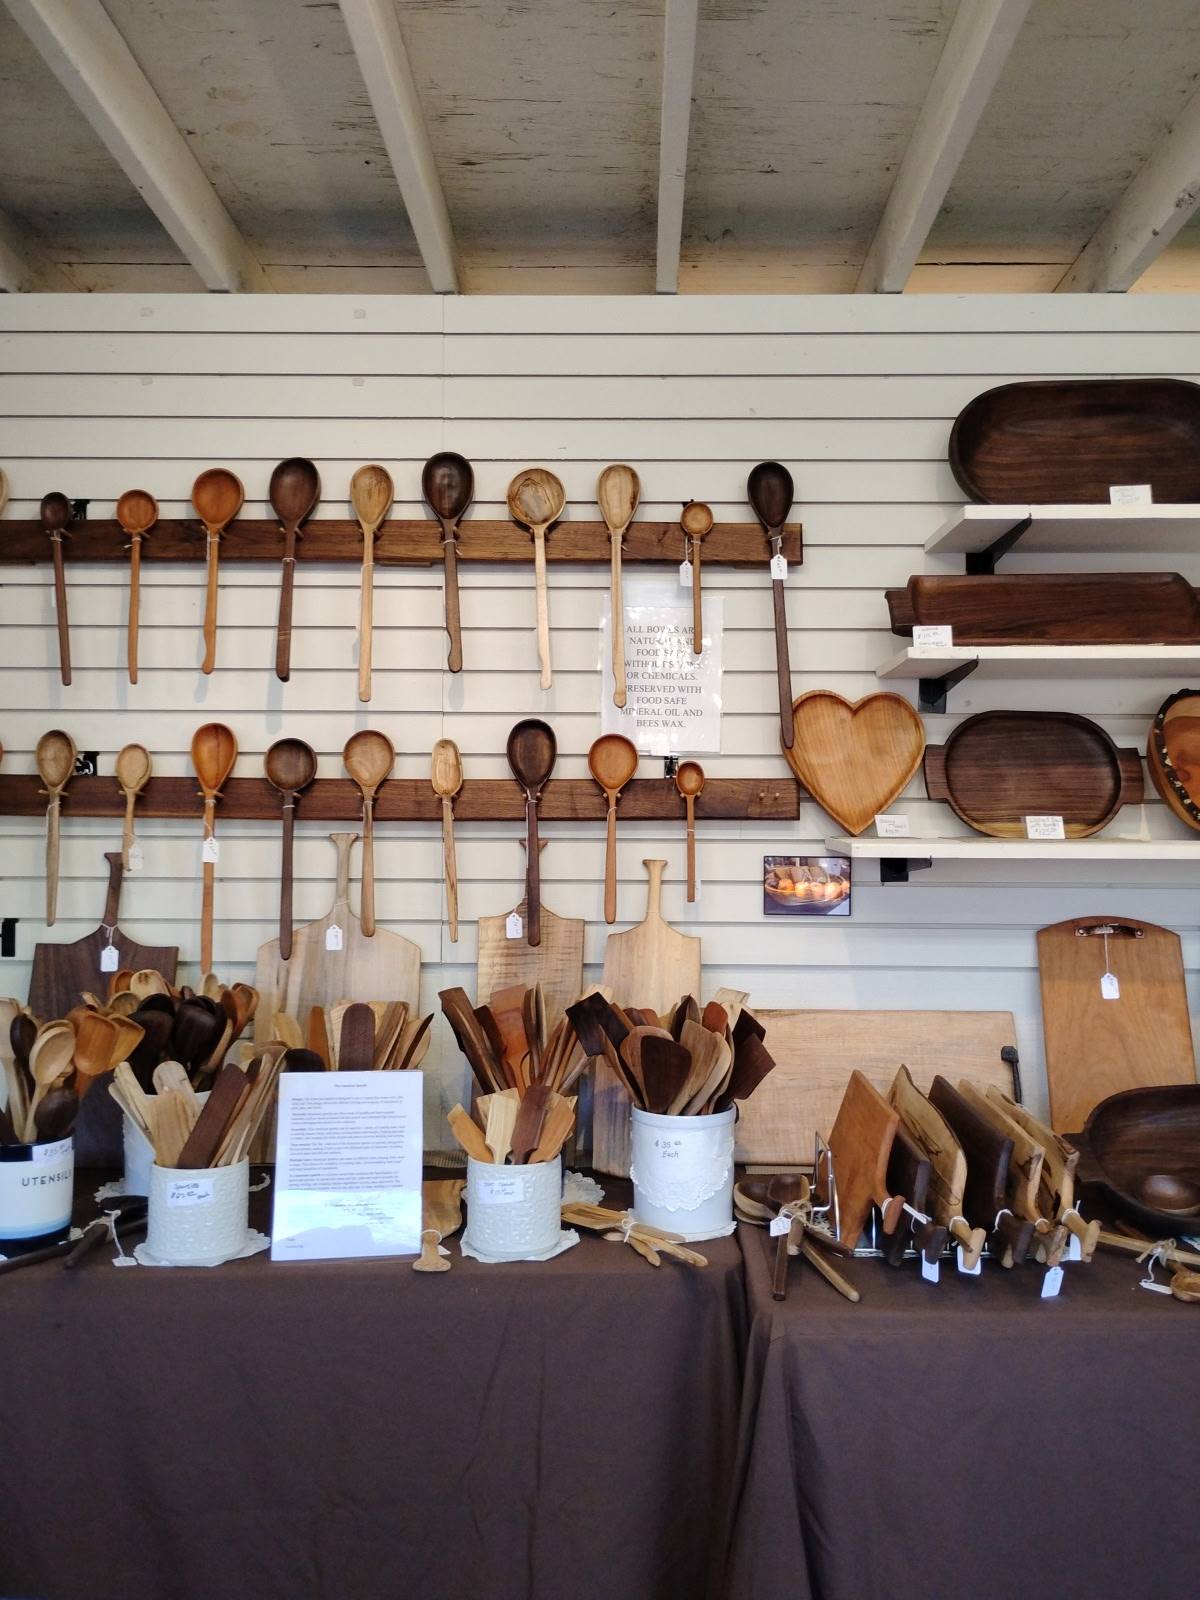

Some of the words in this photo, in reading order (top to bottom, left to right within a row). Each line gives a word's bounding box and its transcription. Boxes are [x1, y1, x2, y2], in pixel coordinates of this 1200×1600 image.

[626, 625, 644, 634] ALL
[682, 626, 695, 635] AR
[626, 671, 639, 680] OR
[625, 685, 675, 694] RESERVED
[677, 685, 702, 694] WITH
[636, 696, 661, 705] FOOD
[663, 697, 687, 705] SAFE
[664, 708, 680, 717] OIL
[682, 709, 703, 717] AND
[636, 719, 659, 728] BEES
